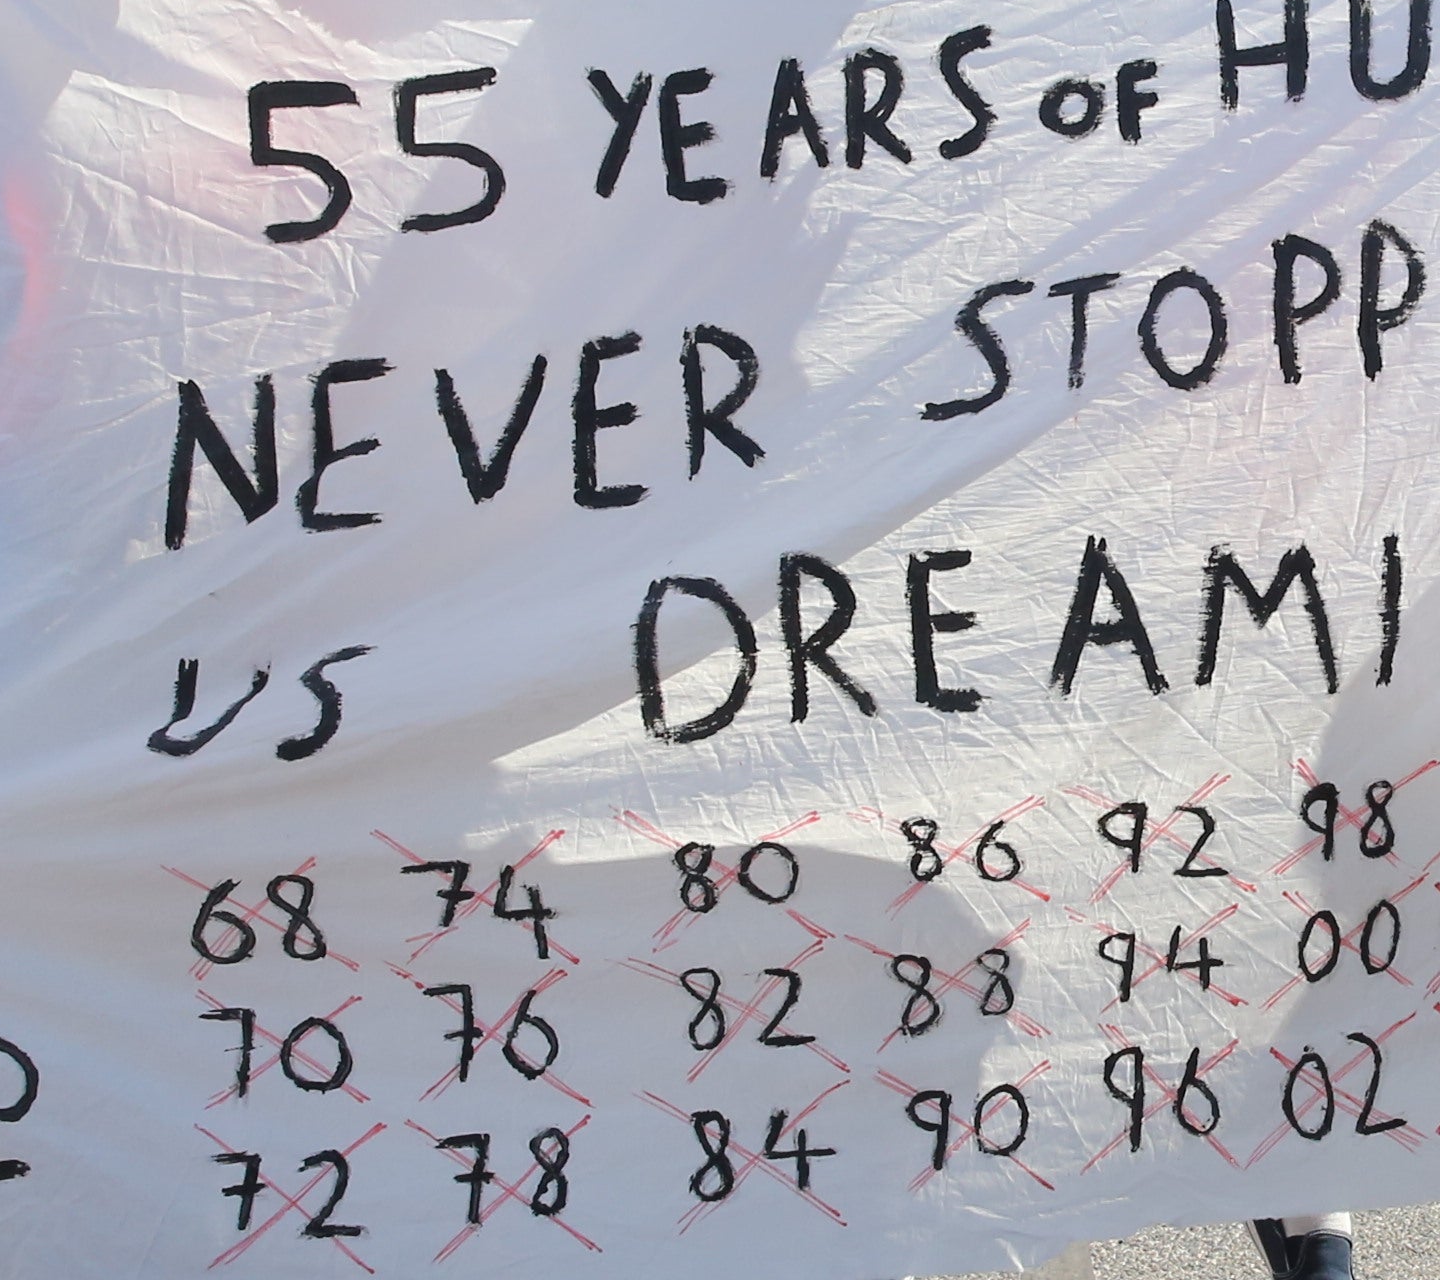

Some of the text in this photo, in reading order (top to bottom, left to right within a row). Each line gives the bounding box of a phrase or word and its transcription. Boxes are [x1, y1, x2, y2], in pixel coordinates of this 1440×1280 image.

[246, 65, 507, 245] 55
[586, 23, 1000, 206] YEARS
[1037, 58, 1160, 146] OF
[163, 323, 766, 550] NEVER
[145, 645, 373, 763] US
[189, 873, 328, 966] 68
[399, 858, 558, 961] 74
[673, 840, 801, 915] 80
[898, 817, 1022, 884] 86
[1096, 801, 1230, 879] 92
[1298, 779, 1397, 863] 98
[197, 1006, 355, 1100] 70
[428, 982, 560, 1084] 76
[678, 966, 817, 1052] 82
[889, 946, 1016, 1039] 88
[1097, 924, 1225, 1004] 94
[1296, 897, 1402, 985] 00
[210, 1148, 363, 1240] 72
[433, 1126, 571, 1226] 78
[688, 1108, 838, 1204] 84
[903, 1082, 1031, 1172] 90
[1102, 1045, 1222, 1154] 96
[1280, 1031, 1409, 1142] 02
